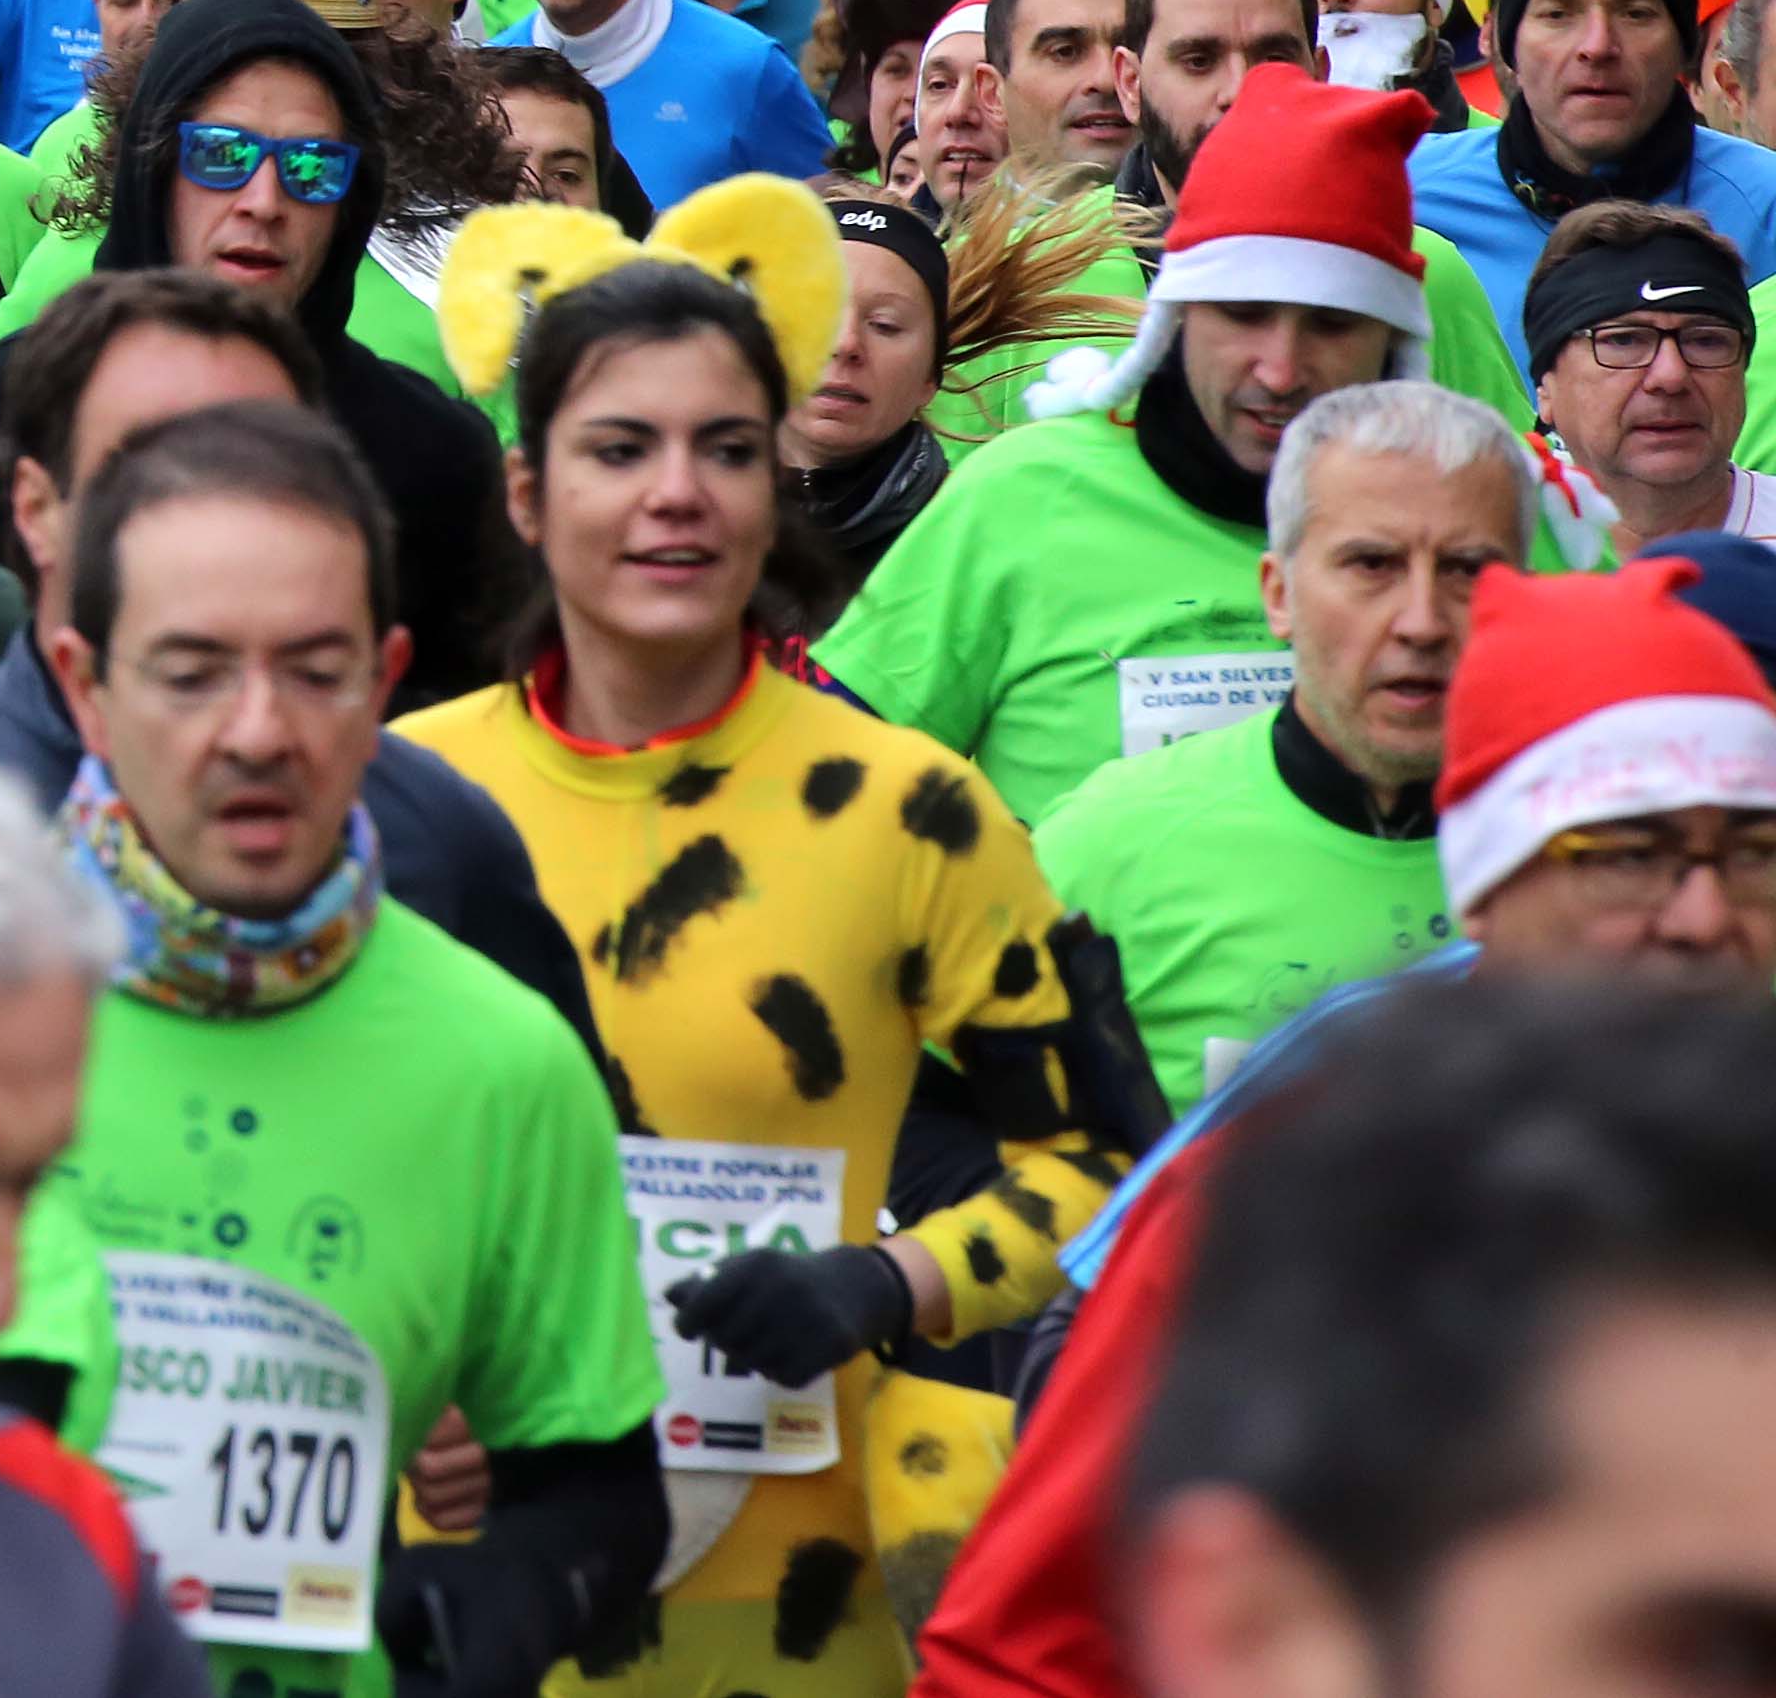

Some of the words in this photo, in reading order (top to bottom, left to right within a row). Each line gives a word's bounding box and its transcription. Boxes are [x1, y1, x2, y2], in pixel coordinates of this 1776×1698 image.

[839, 209, 888, 232] edp
[1148, 671, 1164, 686] V
[1170, 669, 1212, 686] SAN
[1142, 691, 1221, 708] CIUDAD
[1228, 689, 1256, 704] DE
[712, 1159, 818, 1179] POPULAR
[222, 1354, 367, 1416] JAVIER
[209, 1425, 359, 1544] 1370
